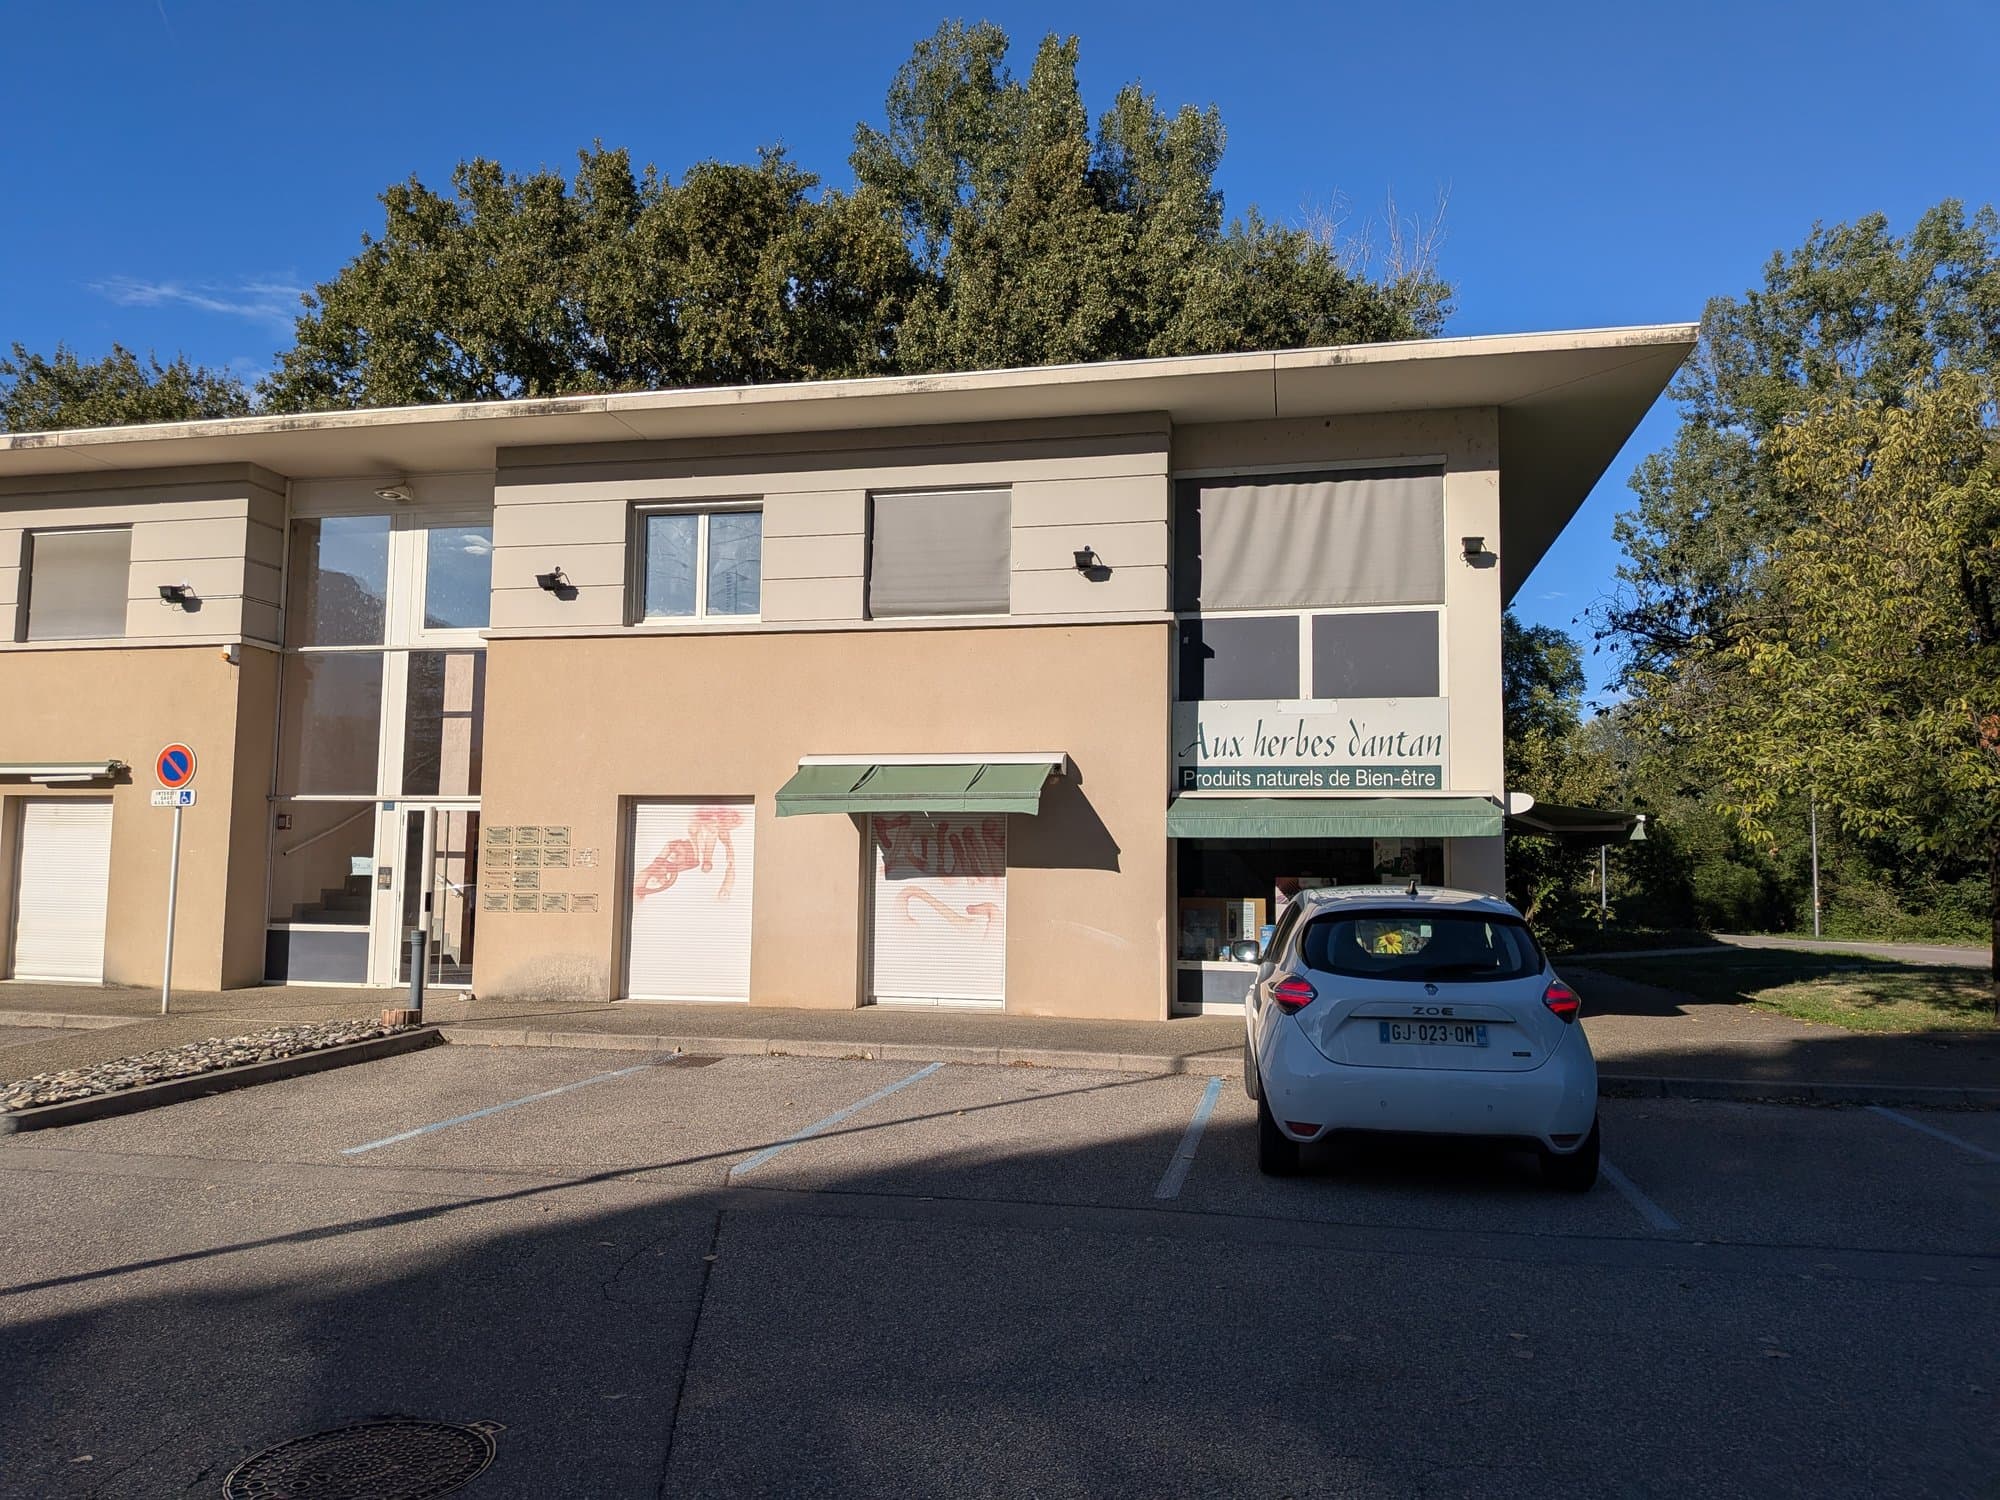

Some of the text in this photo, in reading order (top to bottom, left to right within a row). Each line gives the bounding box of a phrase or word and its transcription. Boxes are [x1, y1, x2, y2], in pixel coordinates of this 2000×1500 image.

[1178, 718, 1442, 760] Aux herbes d'antan
[1183, 768, 1436, 787] Produits naturels de Bien-être
[1412, 1006, 1454, 1016] ZOE
[1391, 1024, 1475, 1043] GJ-023-QM
